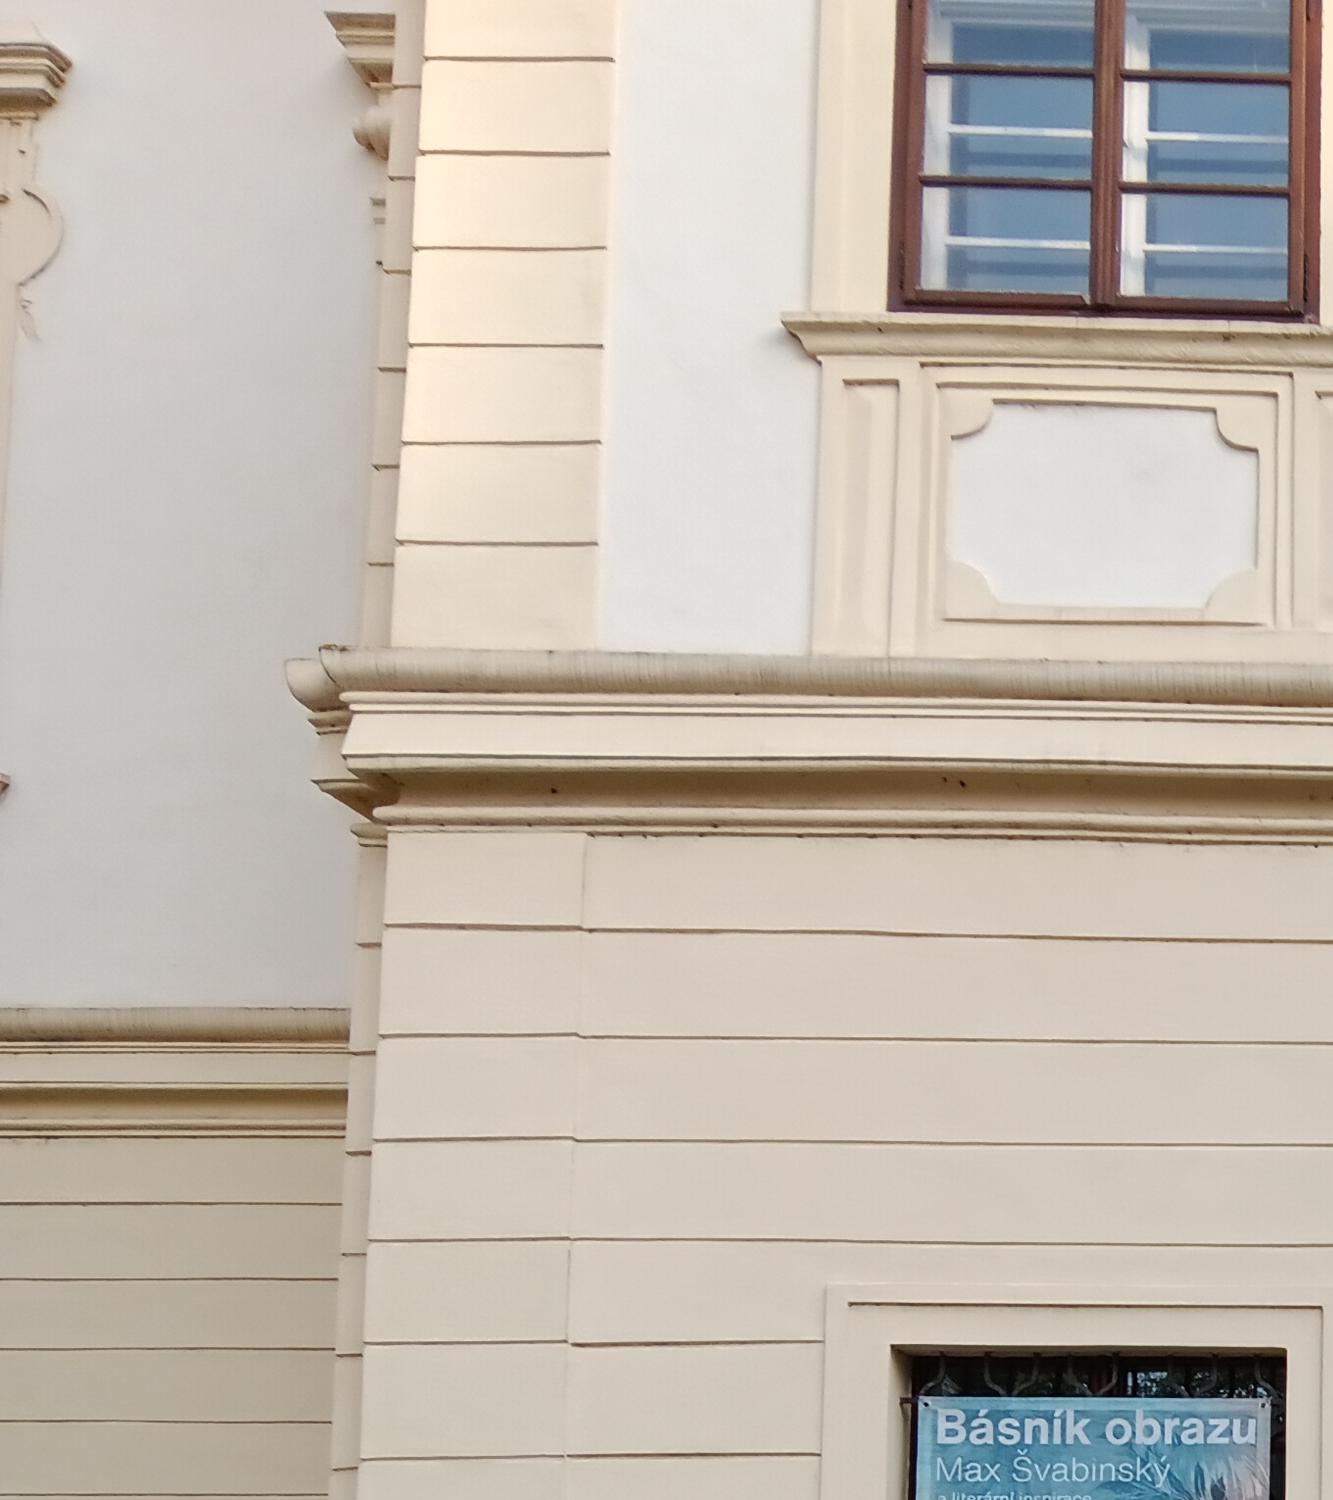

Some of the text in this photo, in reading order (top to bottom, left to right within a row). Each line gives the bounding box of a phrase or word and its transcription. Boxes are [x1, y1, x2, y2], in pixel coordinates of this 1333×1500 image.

[936, 1407, 1257, 1446] Básník obrazu
[936, 1449, 1172, 1488] Max Švabinský
